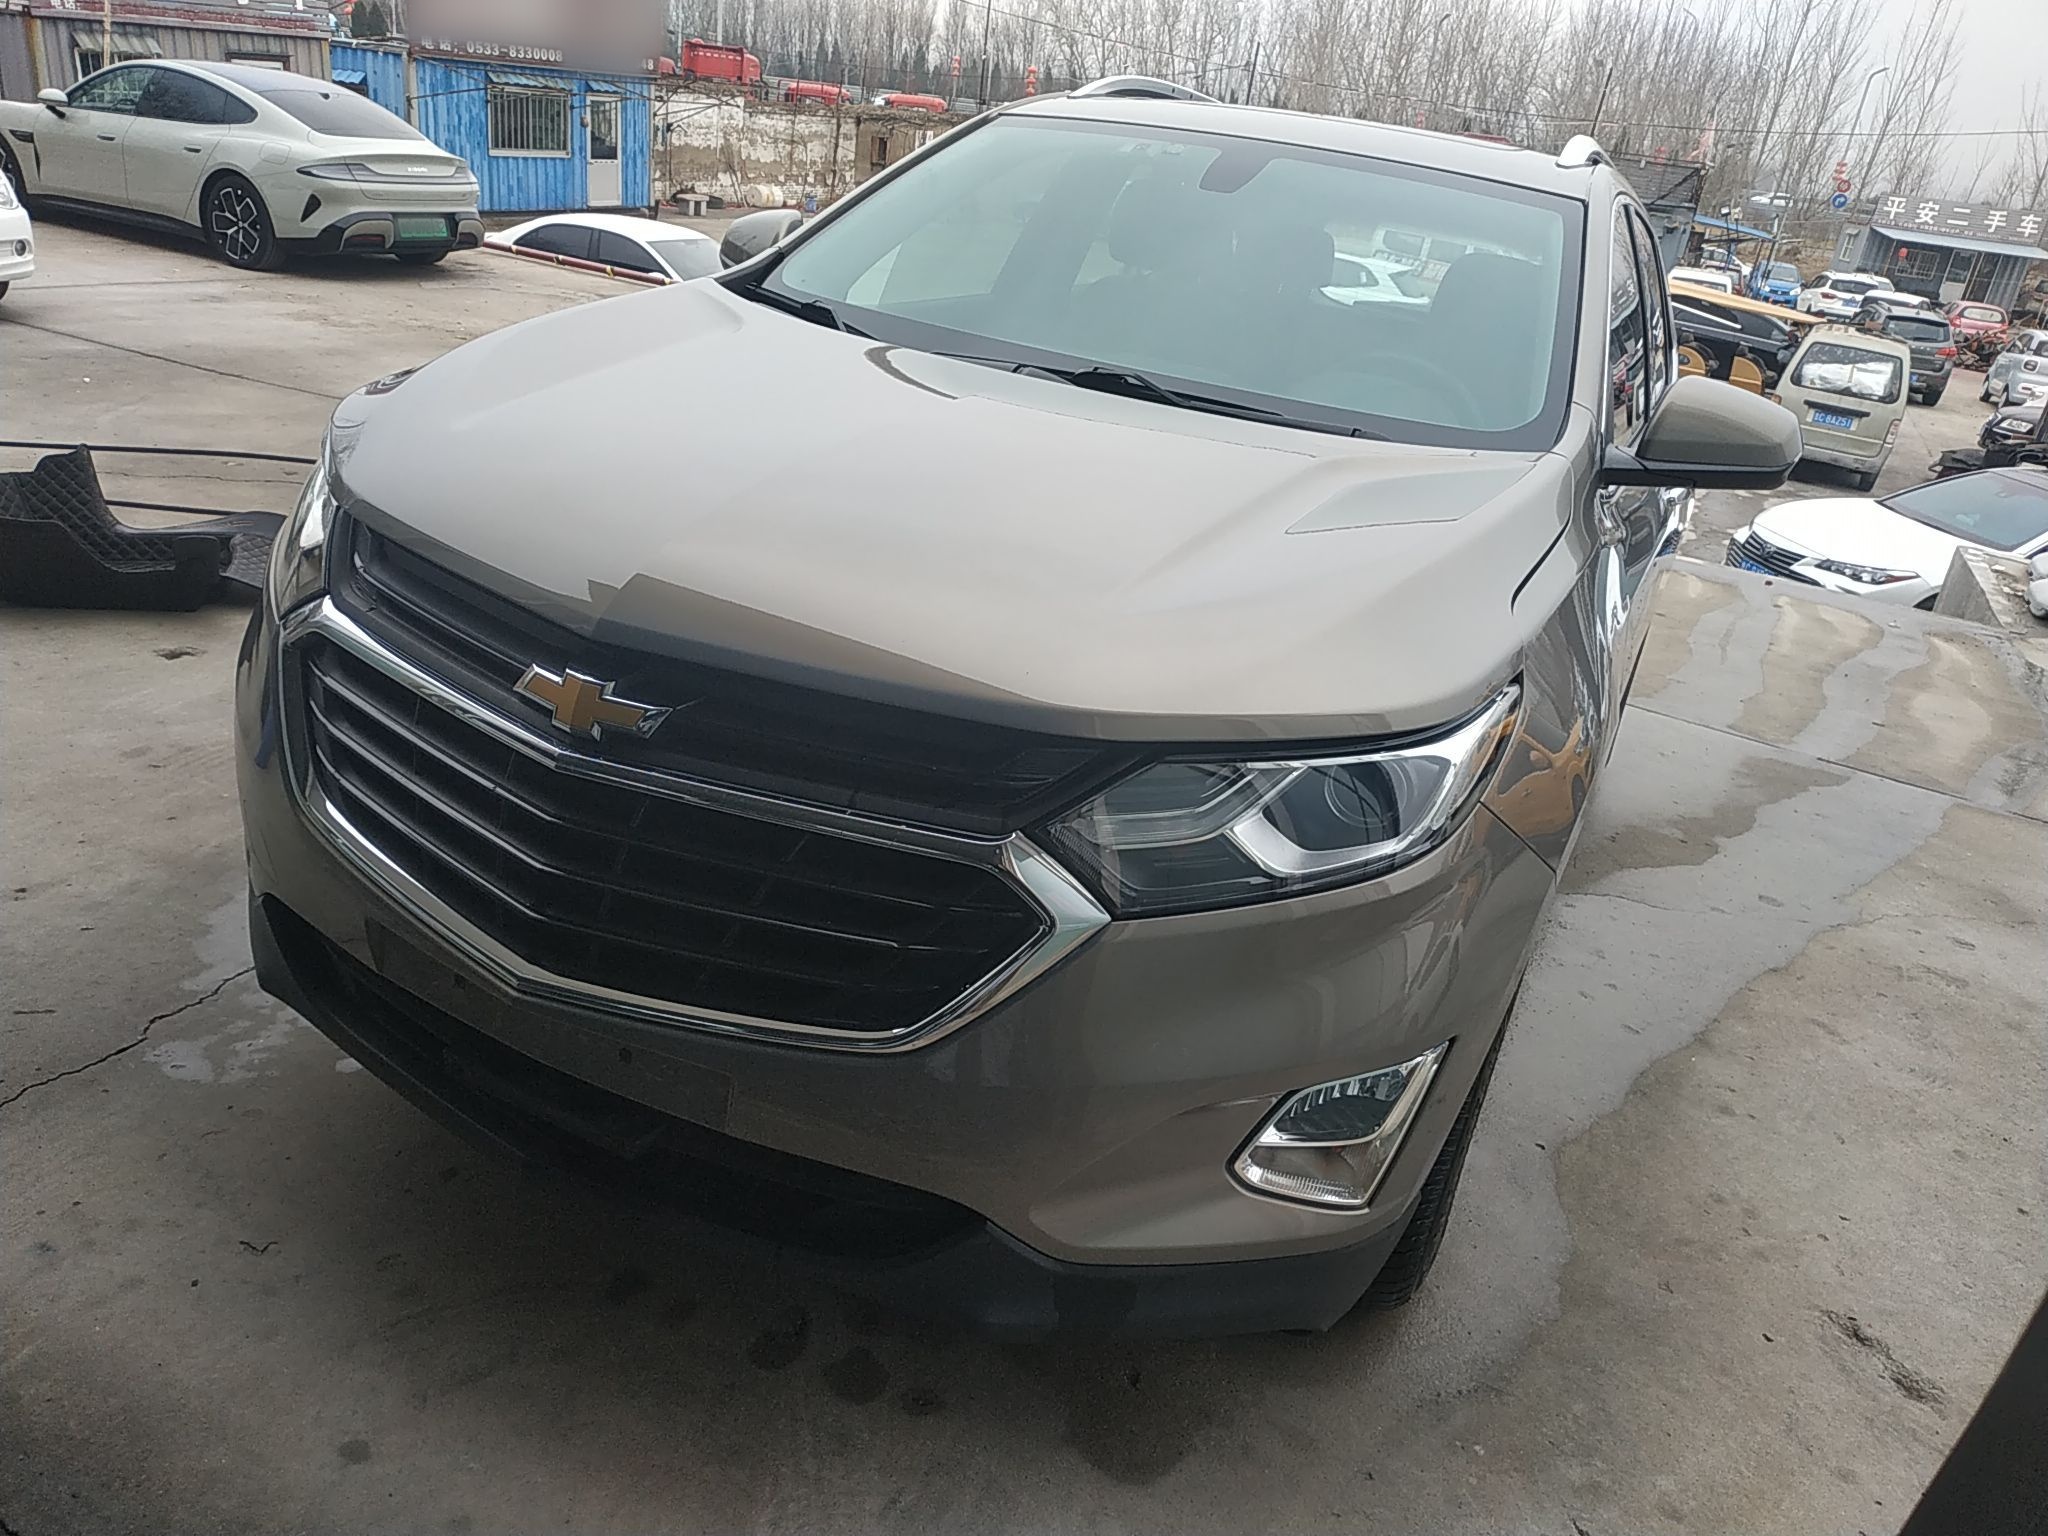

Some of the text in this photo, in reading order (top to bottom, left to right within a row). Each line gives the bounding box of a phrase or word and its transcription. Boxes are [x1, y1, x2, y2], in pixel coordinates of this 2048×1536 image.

[1883, 196, 2042, 237] 平安二手车
